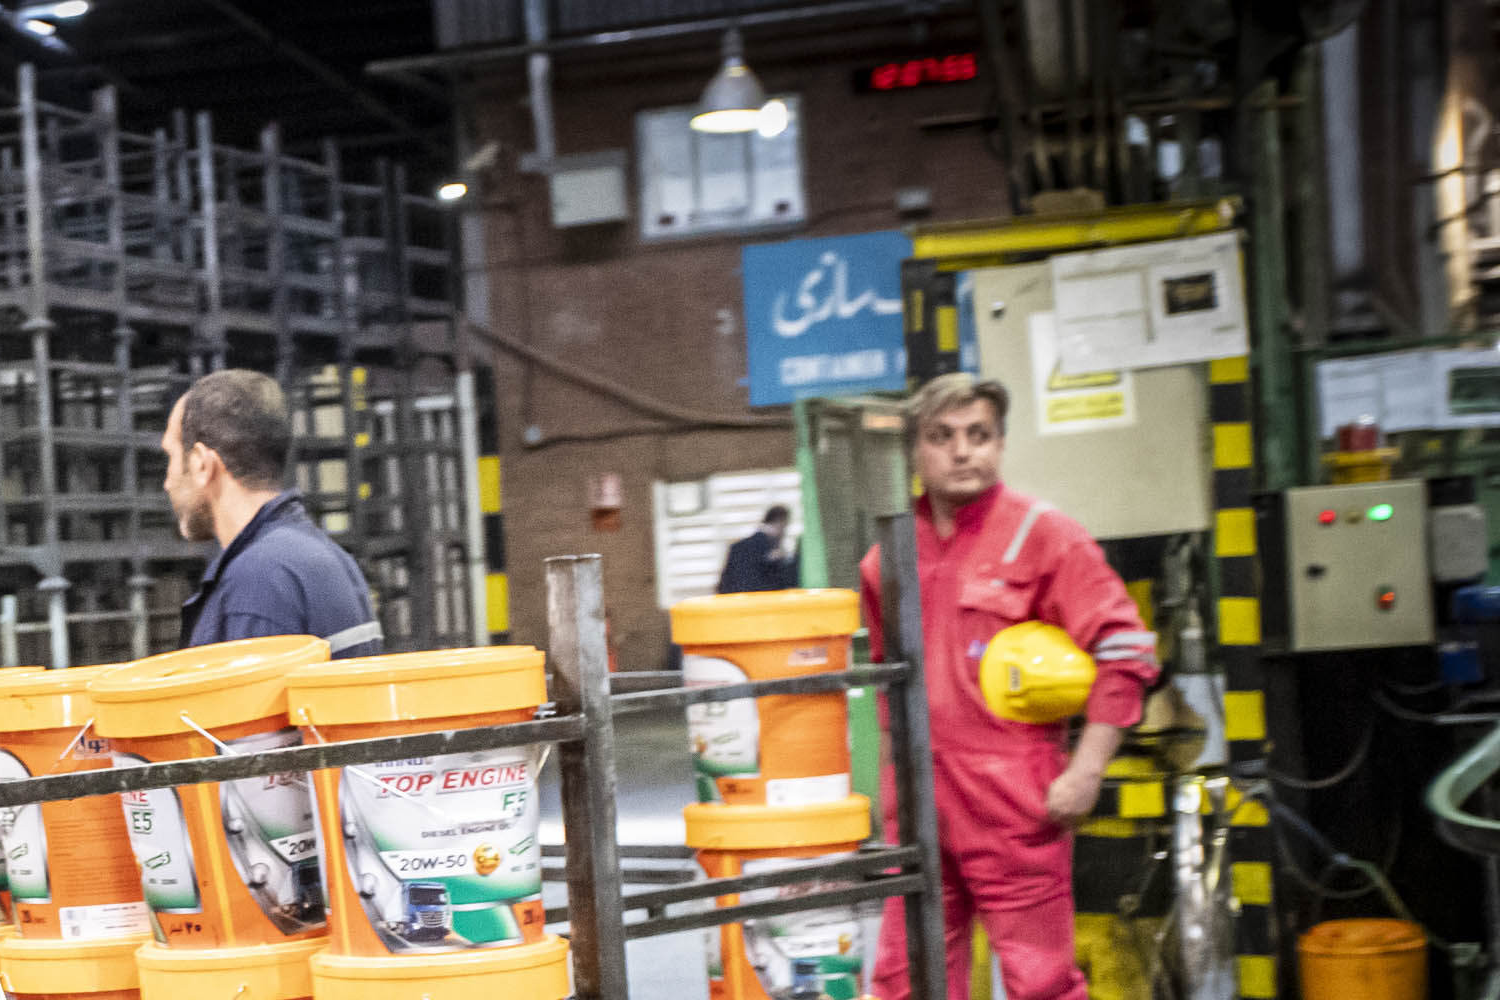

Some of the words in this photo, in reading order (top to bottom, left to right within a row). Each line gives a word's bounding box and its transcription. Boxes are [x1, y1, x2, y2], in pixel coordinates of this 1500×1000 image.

[380, 774, 434, 795] TOP
[442, 763, 527, 790] ENGINE
[131, 810, 153, 832] E5
[400, 854, 468, 872] 20W-50
